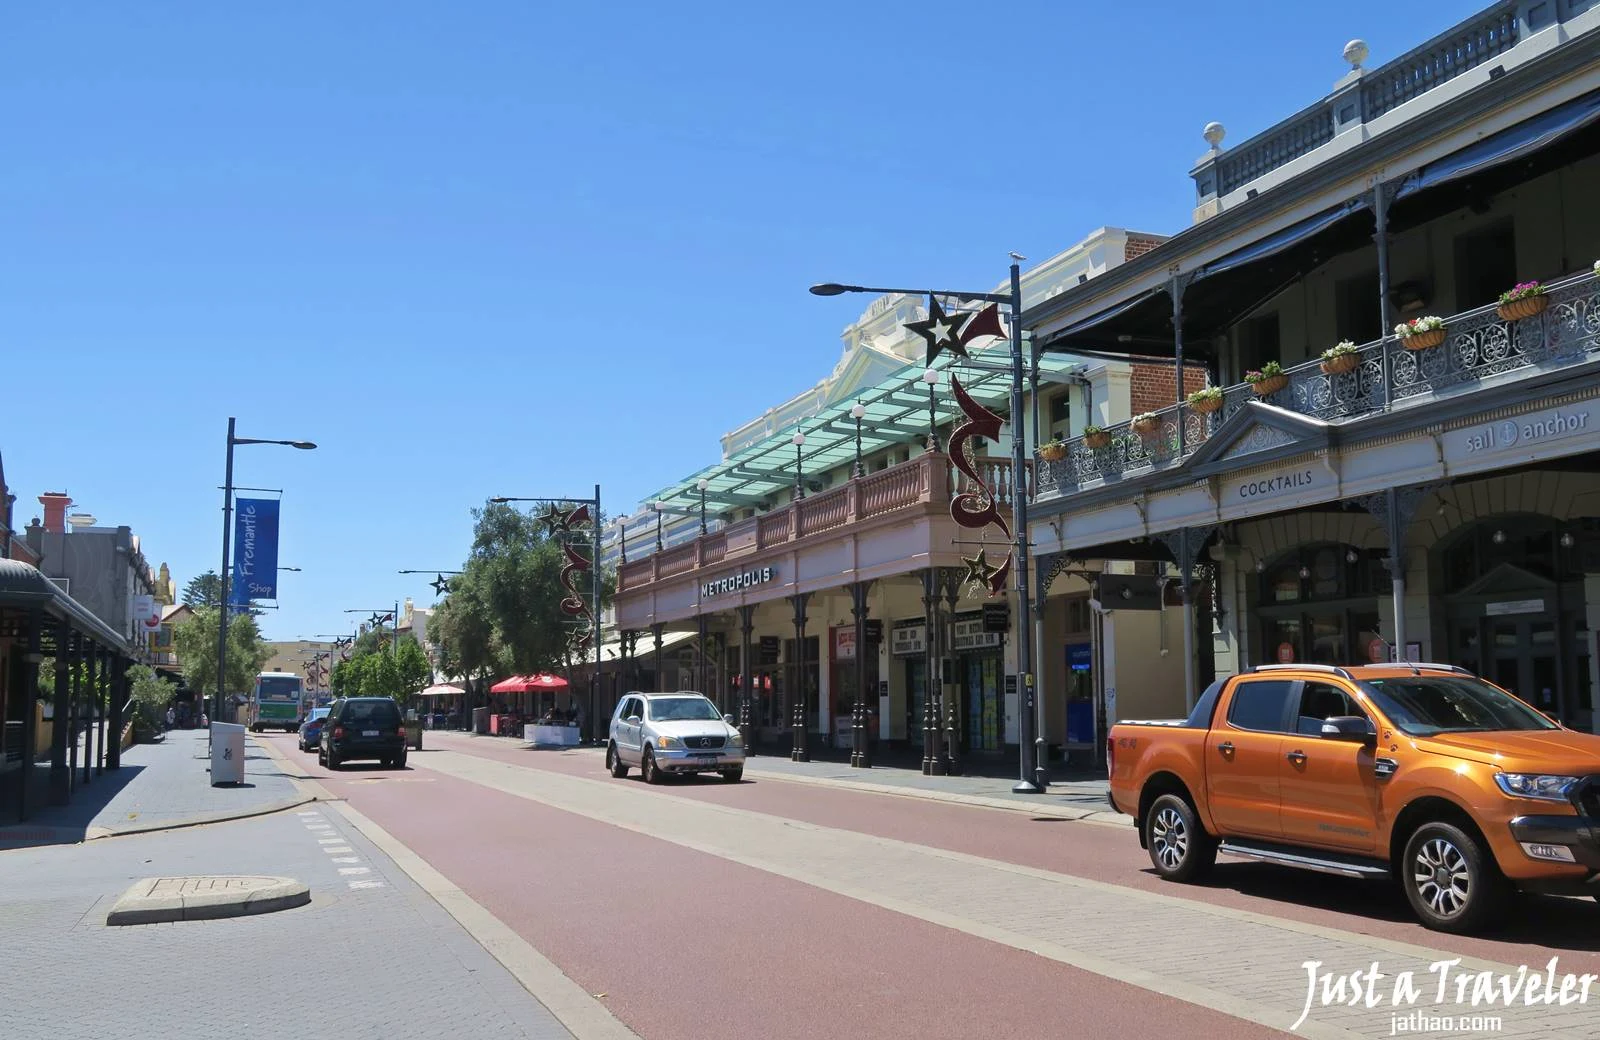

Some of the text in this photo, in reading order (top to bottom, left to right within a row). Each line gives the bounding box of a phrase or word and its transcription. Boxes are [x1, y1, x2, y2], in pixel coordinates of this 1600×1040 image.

[1466, 411, 1589, 452] sail anchor
[1239, 470, 1312, 498] COCKTAILS
[238, 503, 256, 579] Fremantle
[248, 582, 272, 598] Shop
[701, 567, 771, 598] METROPOLIS
